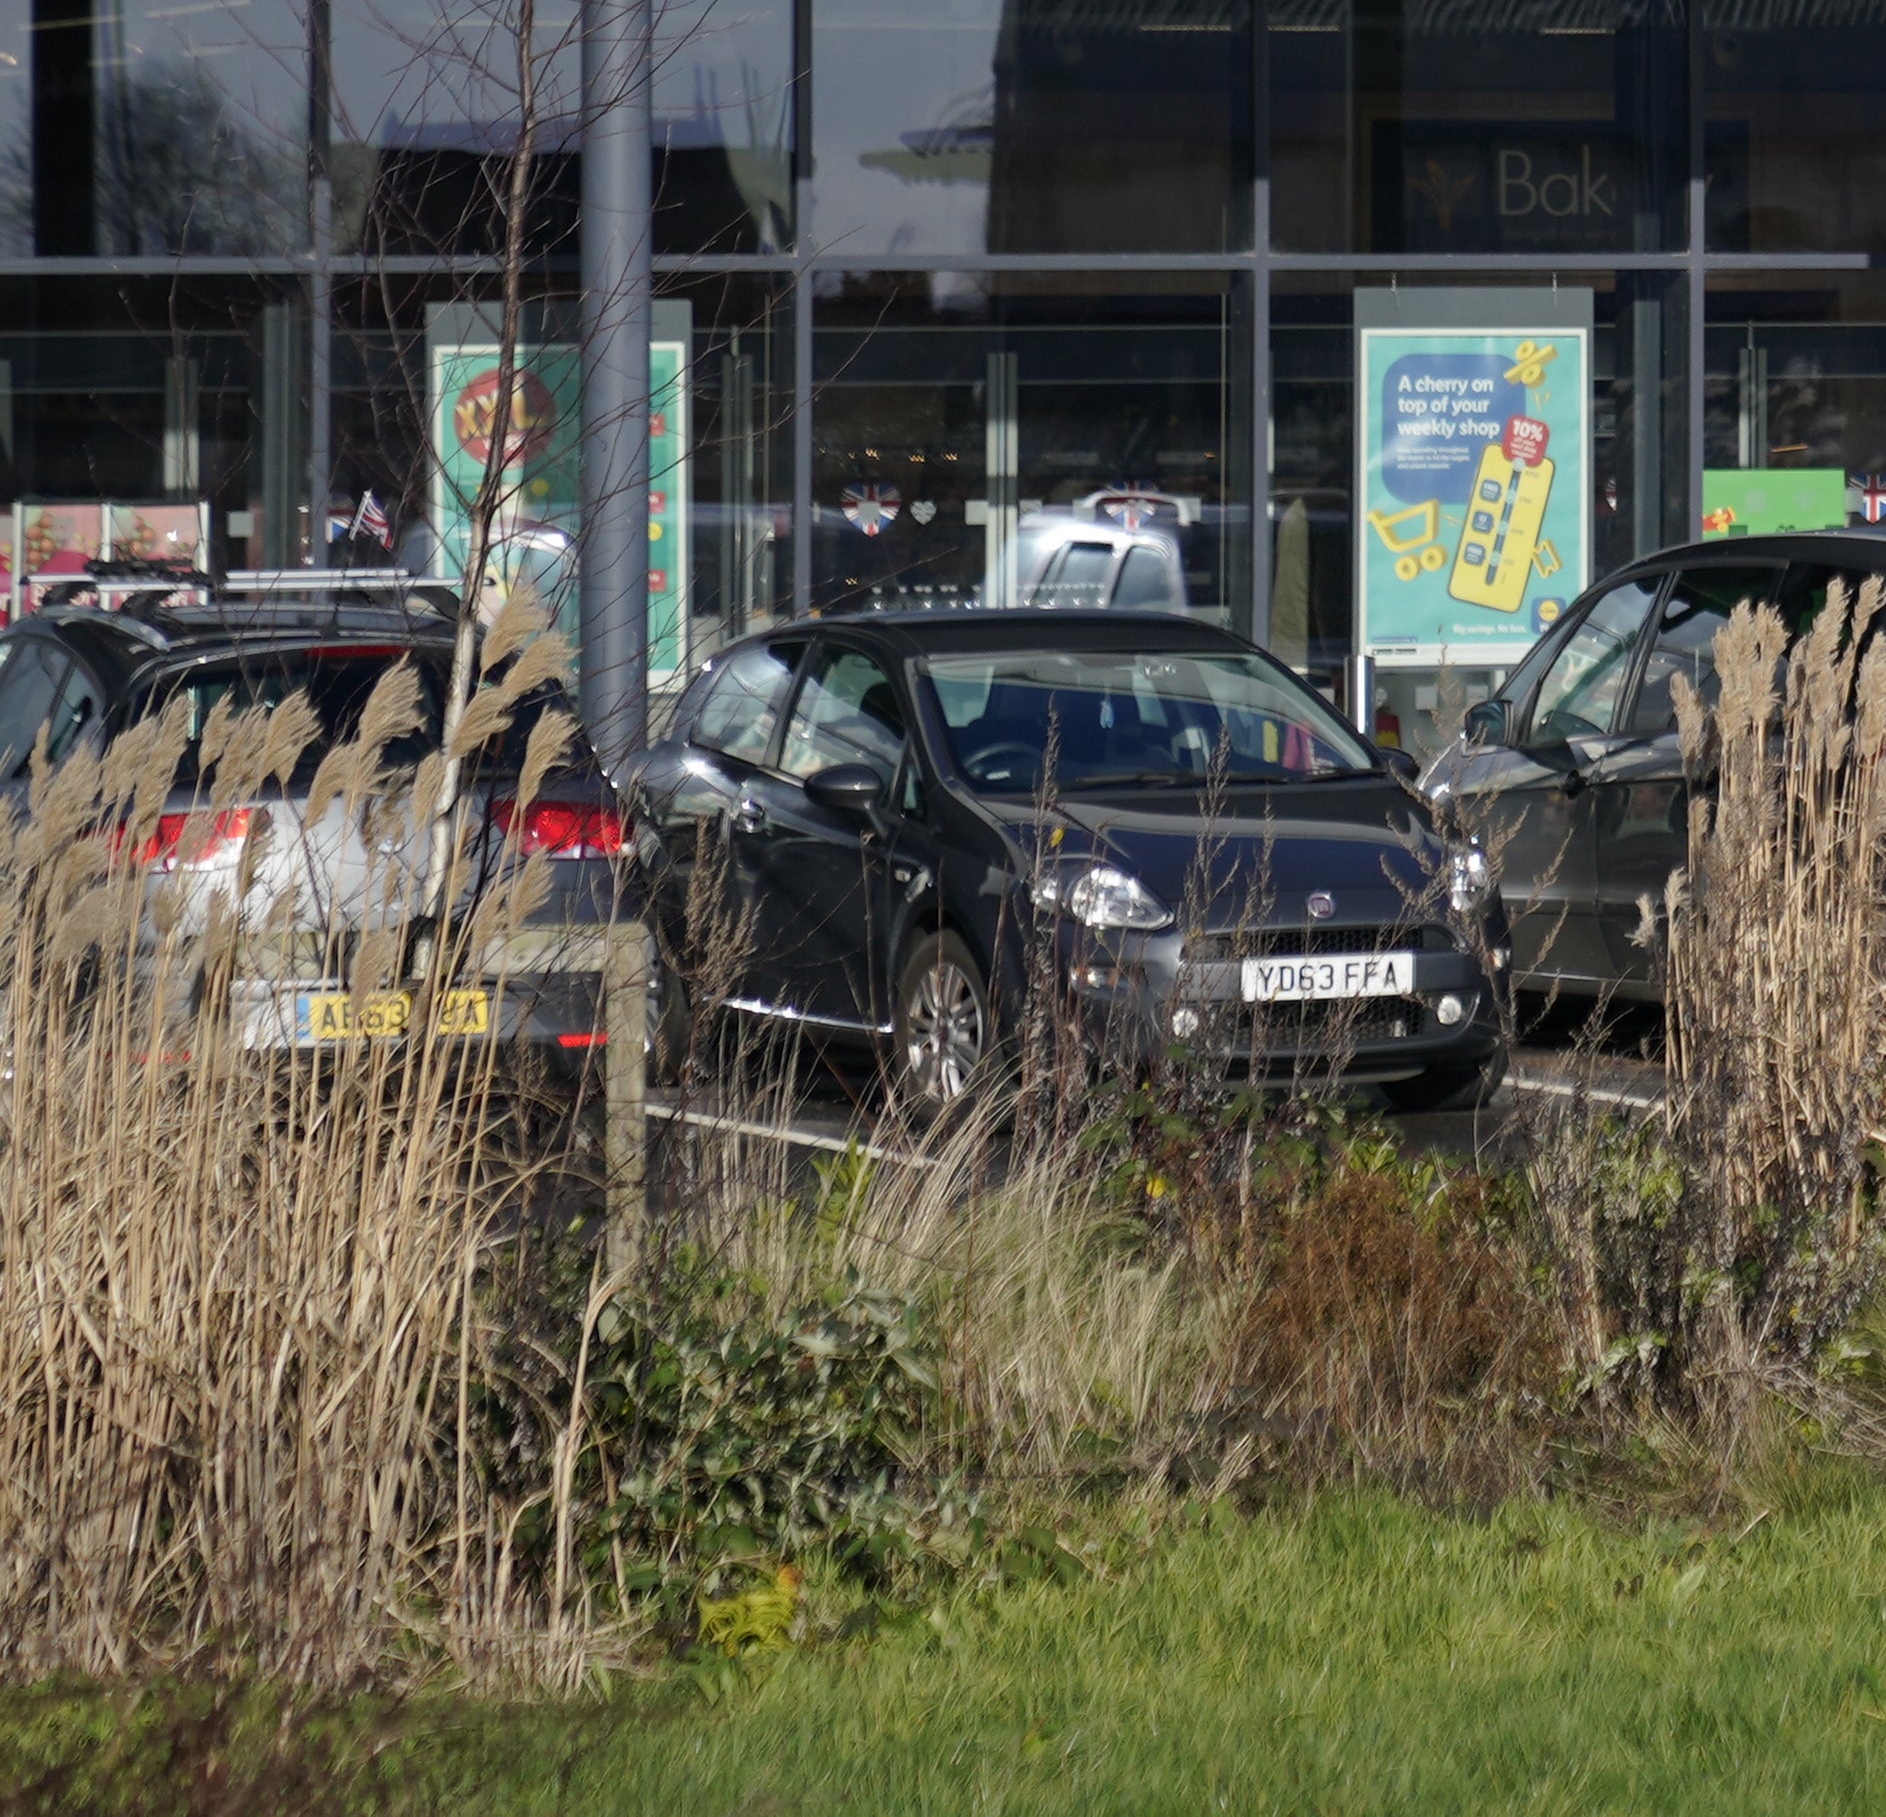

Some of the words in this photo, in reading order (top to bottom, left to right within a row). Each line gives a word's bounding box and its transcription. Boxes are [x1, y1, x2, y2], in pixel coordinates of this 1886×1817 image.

[1399, 375, 1412, 393] A
[1415, 376, 1468, 396] cherry
[1472, 379, 1494, 393] on
[1398, 397, 1427, 416] top
[1430, 396, 1449, 413] of
[1452, 399, 1490, 417] your
[1398, 417, 1455, 439] weekly
[1459, 418, 1500, 439] shop
[1511, 419, 1544, 443] 10%
[1258, 963, 1334, 993] YD63
[1345, 961, 1398, 990] FFA
